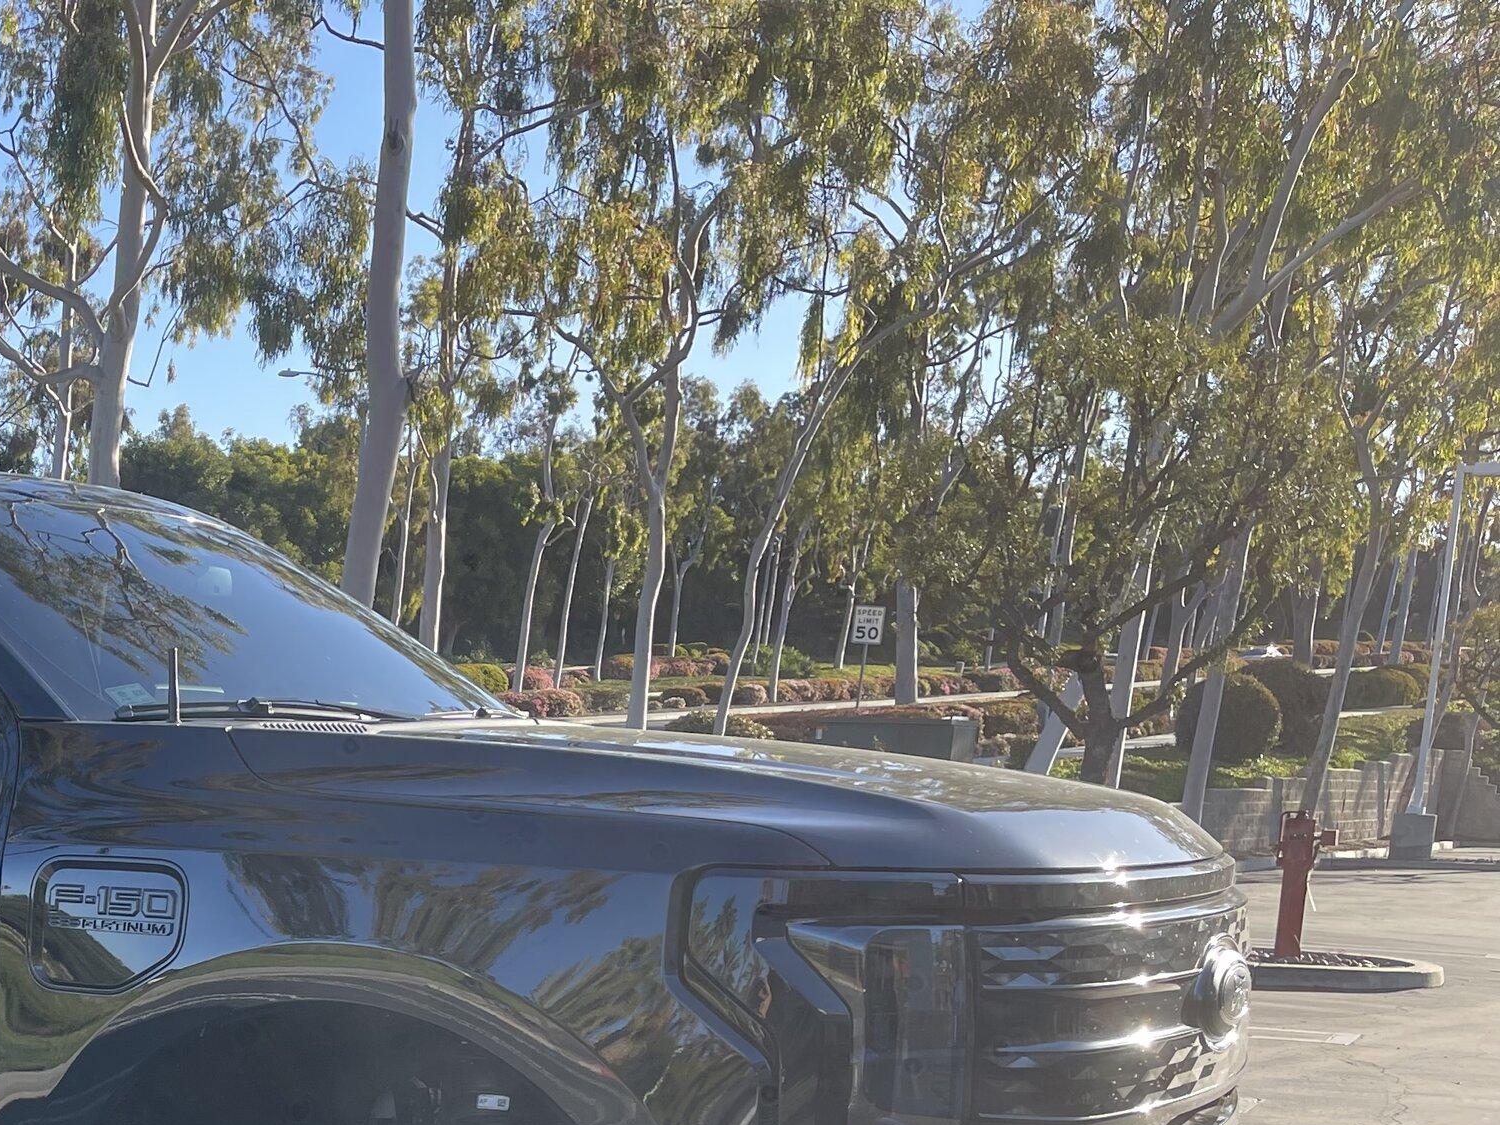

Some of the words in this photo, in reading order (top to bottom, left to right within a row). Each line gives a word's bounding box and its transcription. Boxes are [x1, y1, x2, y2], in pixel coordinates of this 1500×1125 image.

[857, 608, 883, 616] SPEED
[855, 626, 879, 640] 50
[49, 883, 178, 919] F-150
[81, 919, 167, 935] PLATINUM
